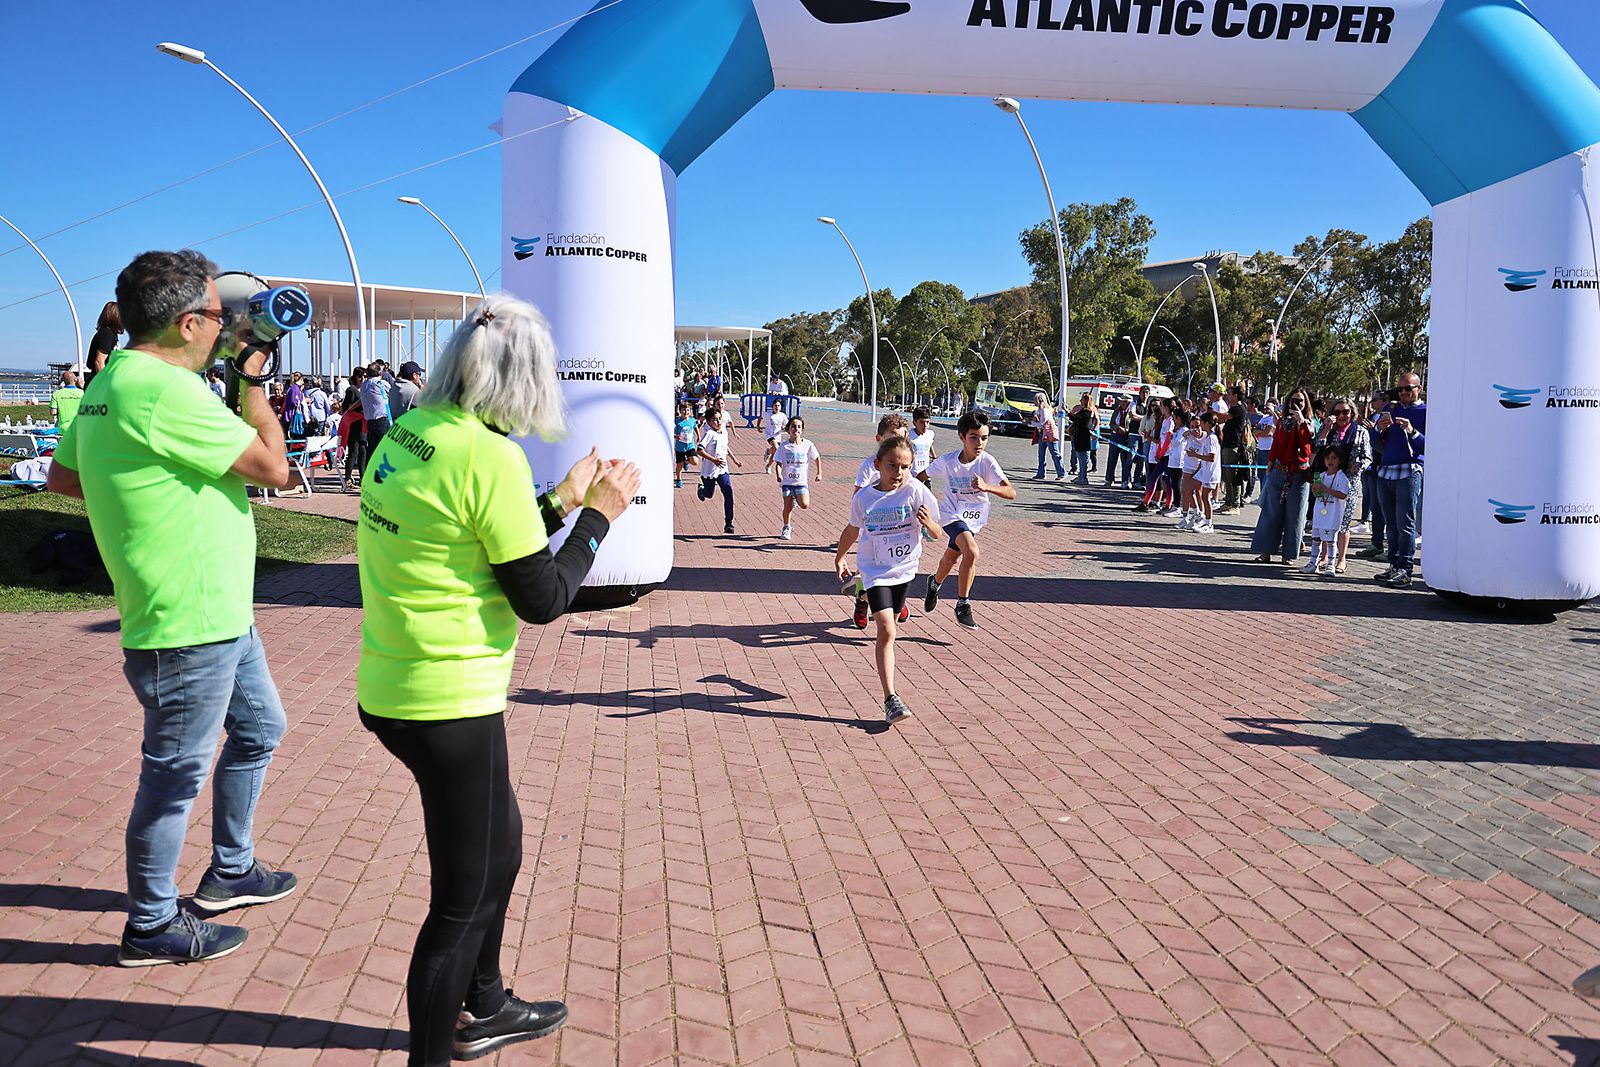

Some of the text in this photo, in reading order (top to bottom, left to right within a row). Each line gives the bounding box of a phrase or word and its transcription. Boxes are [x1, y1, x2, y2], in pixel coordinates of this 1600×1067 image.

[966, 0, 1395, 44] ATLANTIC COPPER
[546, 233, 605, 244] Fundación
[545, 246, 647, 262] ATLANTIC COPPER
[557, 358, 605, 369] ndación
[605, 371, 647, 384] COPPER
[1546, 398, 1599, 408] ATLANTIC
[387, 422, 436, 462] OLUNTARIO
[1543, 502, 1595, 514] Fundación
[962, 510, 981, 520] 056
[1540, 514, 1592, 525] ATLANTIC
[368, 509, 399, 535] COPPER
[888, 544, 911, 558] 162
